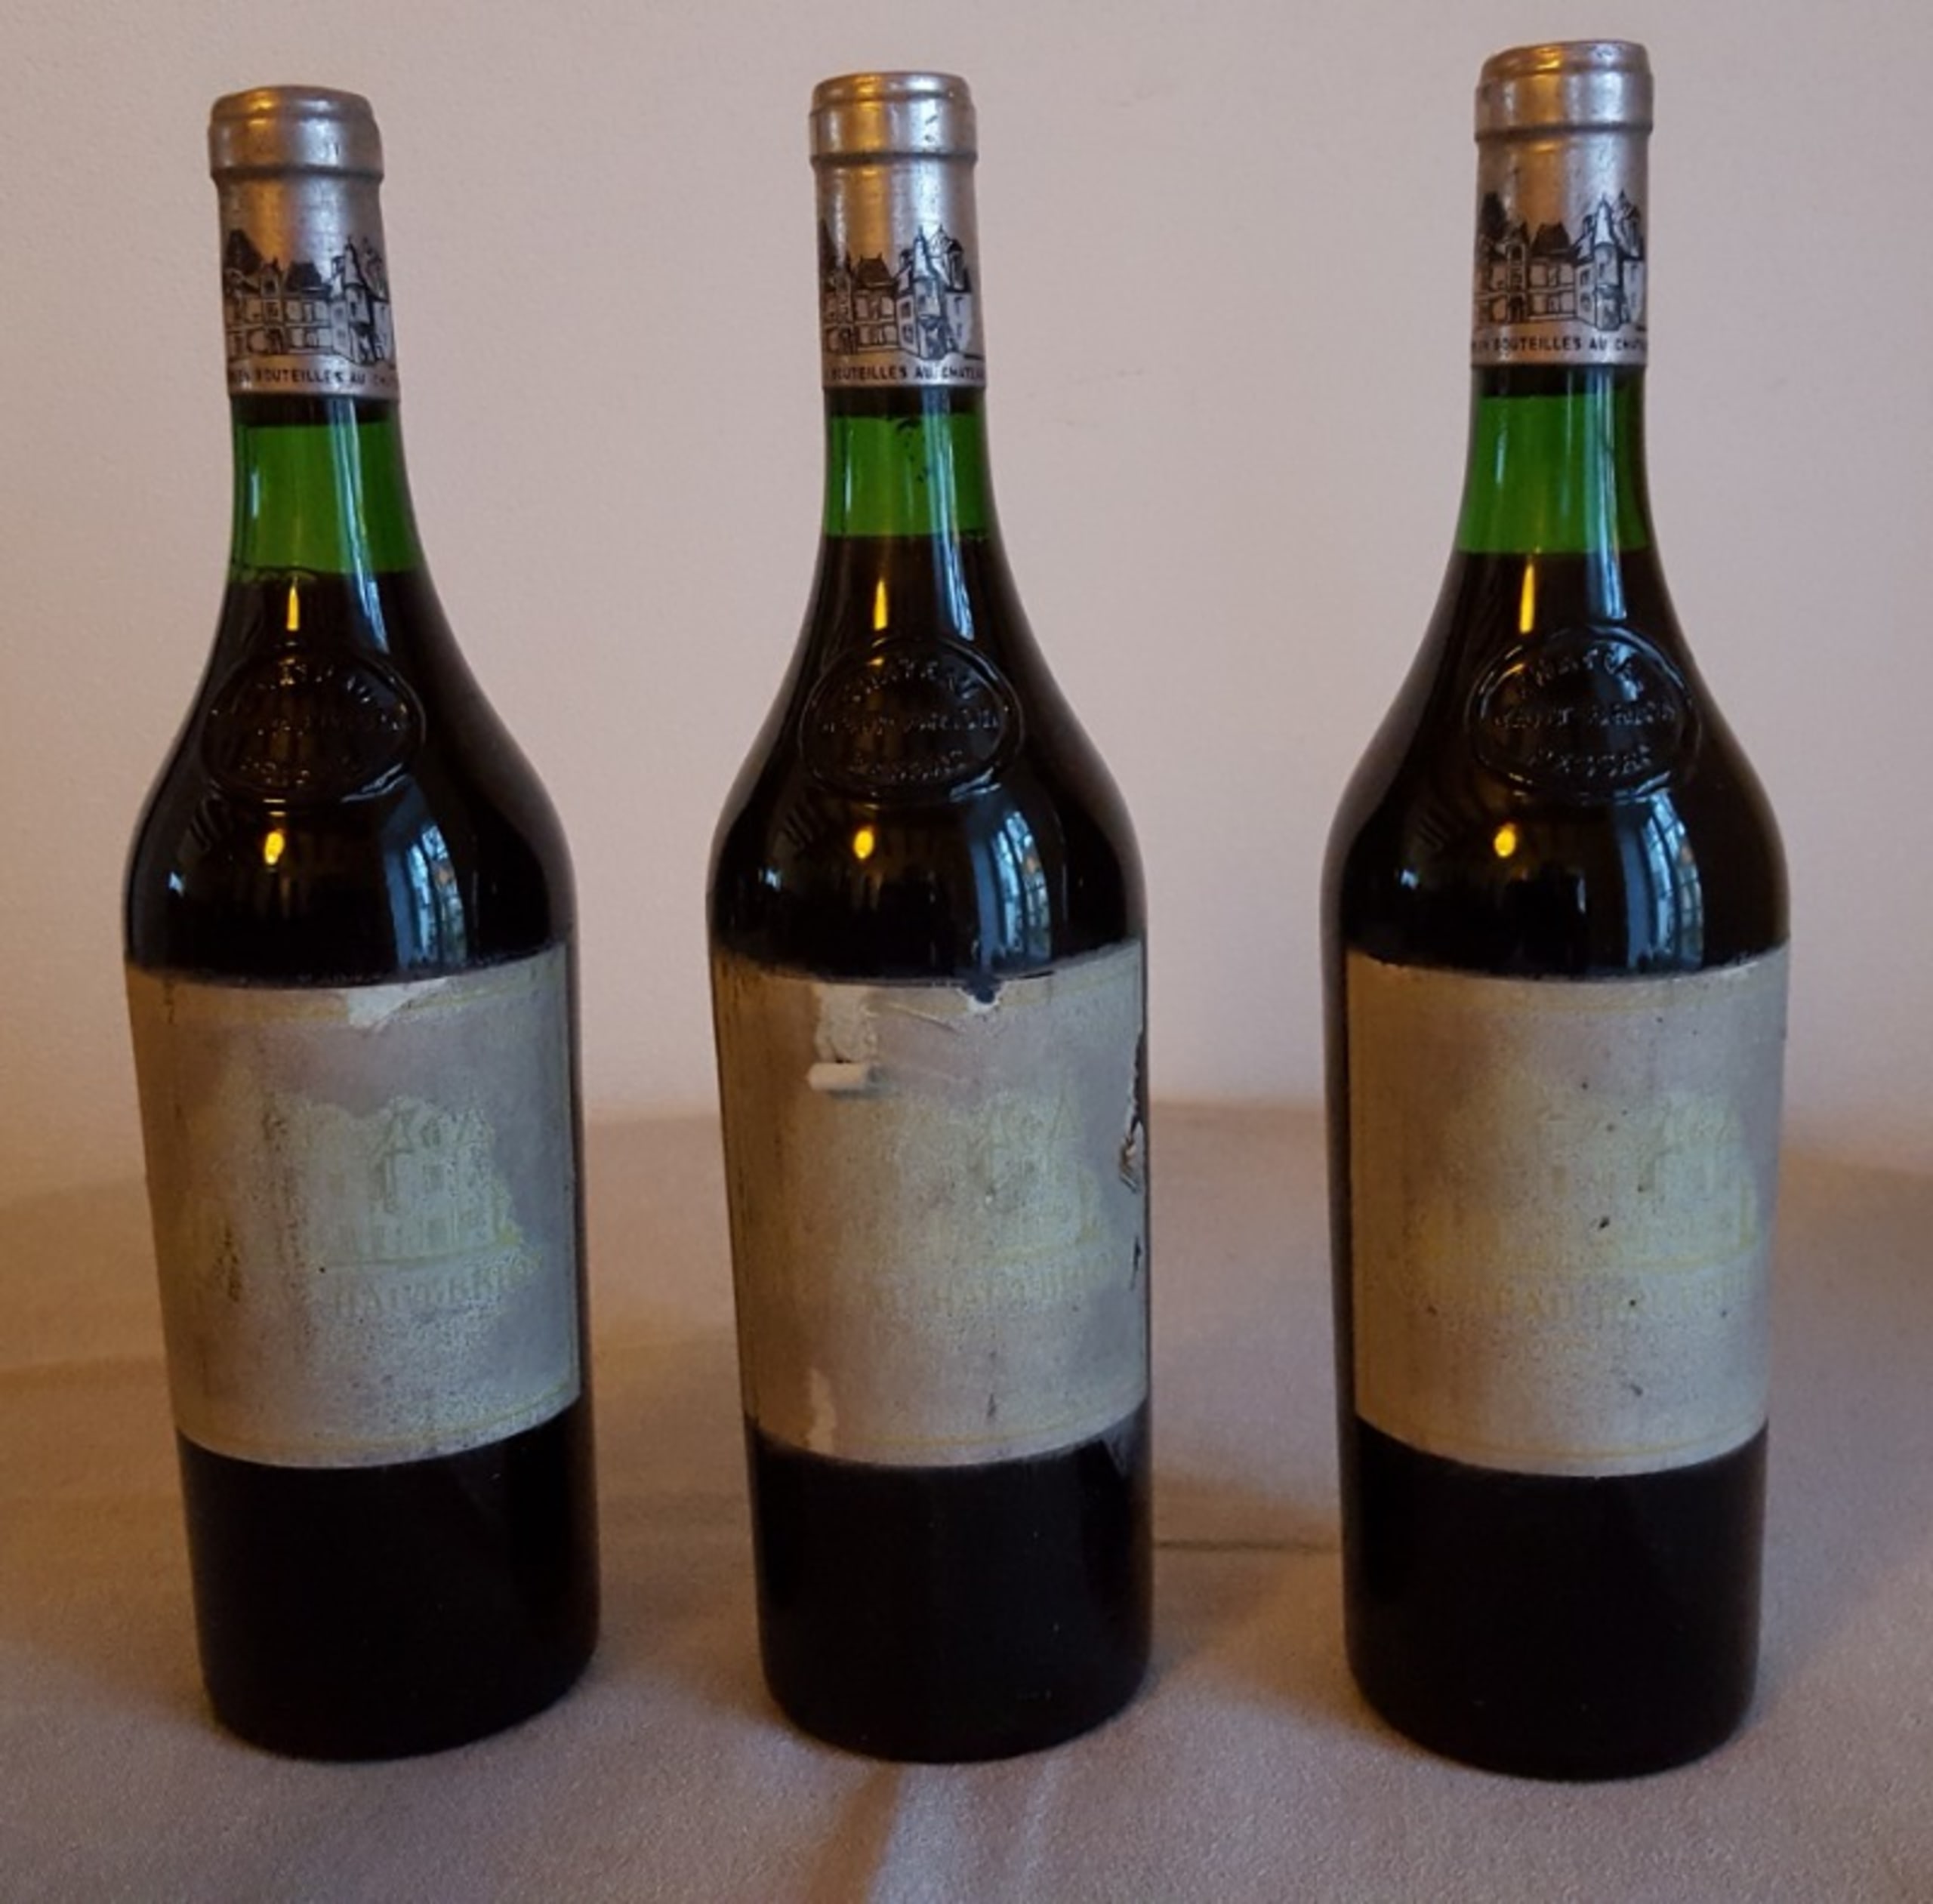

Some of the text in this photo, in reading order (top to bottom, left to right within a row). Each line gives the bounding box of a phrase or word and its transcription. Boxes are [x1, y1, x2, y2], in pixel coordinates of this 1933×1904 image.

[1589, 336, 1607, 351] AU
[350, 371, 366, 384] AU
[914, 365, 935, 379] AU
